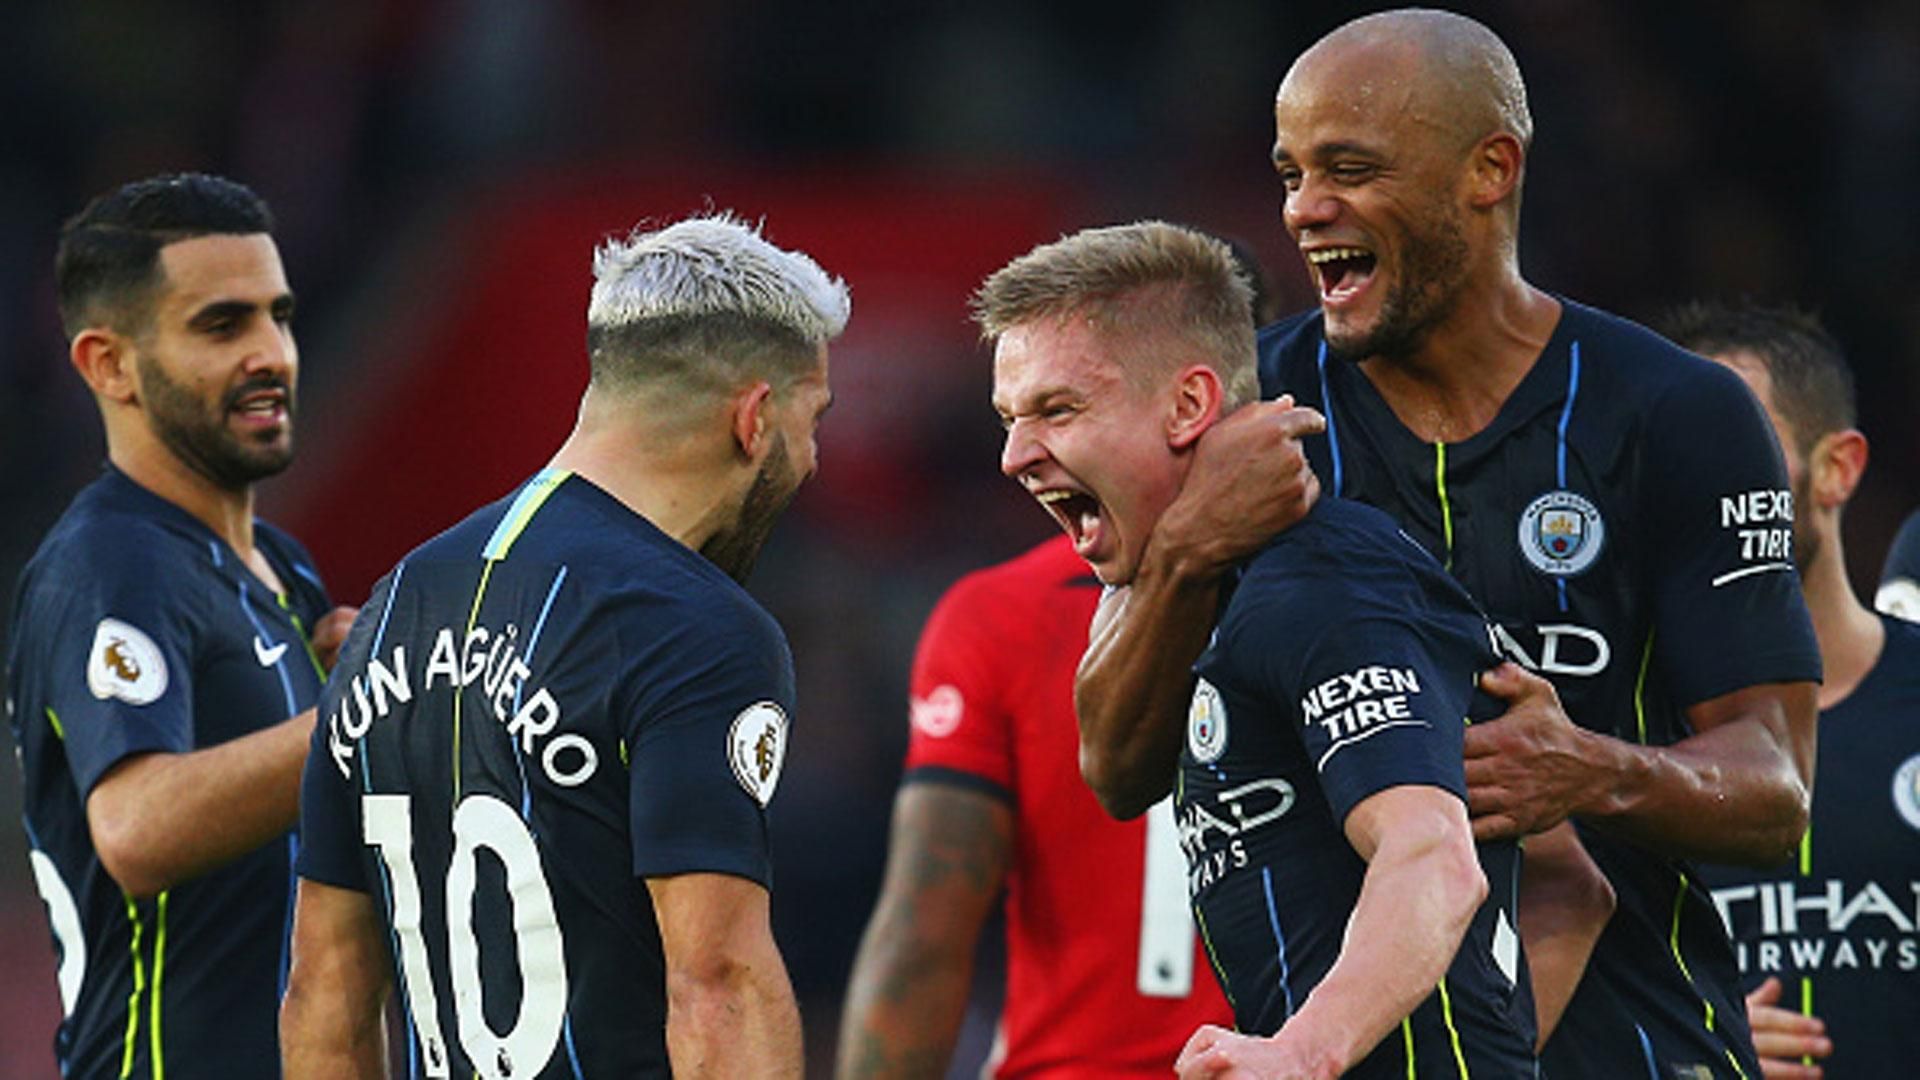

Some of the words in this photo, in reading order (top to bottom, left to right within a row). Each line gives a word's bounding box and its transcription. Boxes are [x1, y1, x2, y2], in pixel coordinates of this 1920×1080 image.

[329, 645, 412, 779] KUN
[1301, 666, 1421, 726] NEXEN
[1320, 695, 1412, 740] TIRE
[361, 795, 568, 1080] 10
[1710, 879, 1920, 939] TIHA
[1737, 938, 1918, 973] IRWAYS
